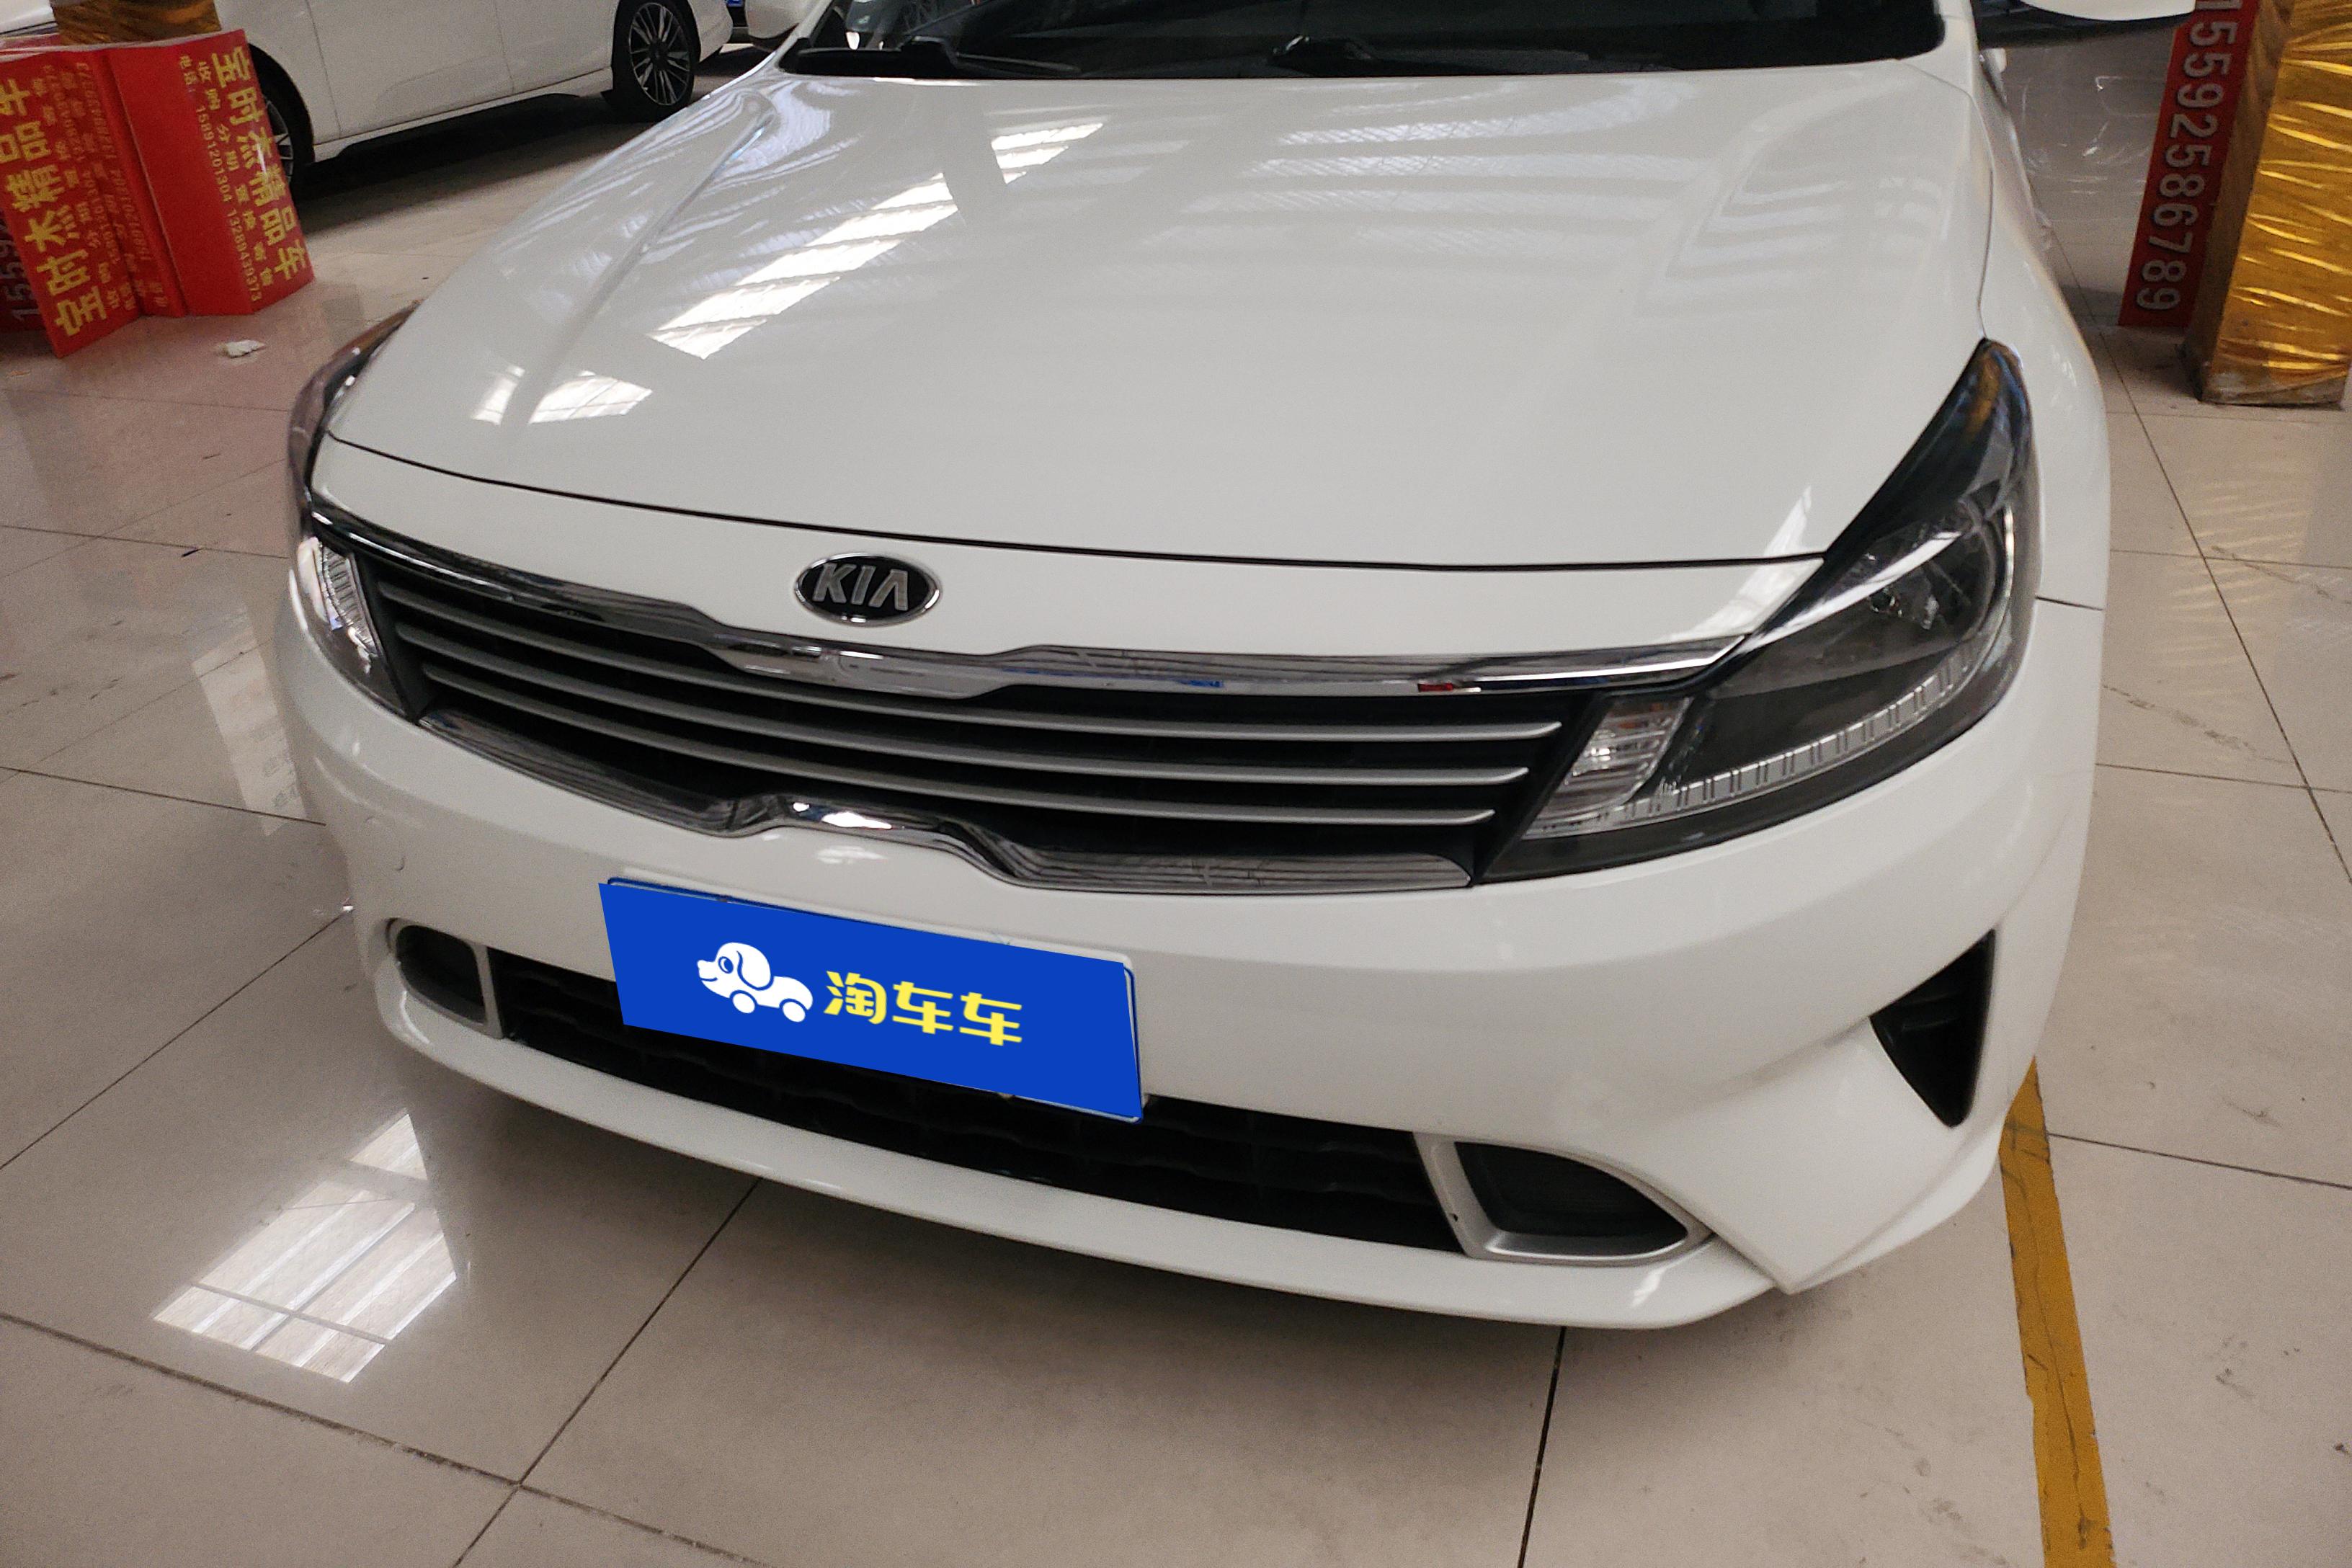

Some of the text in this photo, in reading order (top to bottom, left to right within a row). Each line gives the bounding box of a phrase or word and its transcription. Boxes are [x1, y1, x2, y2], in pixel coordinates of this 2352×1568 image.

[212, 45, 306, 280] 宝时杰精品车
[2136, 0, 2239, 311] 15592586789
[0, 225, 40, 321] 1559
[812, 563, 909, 611] KIA
